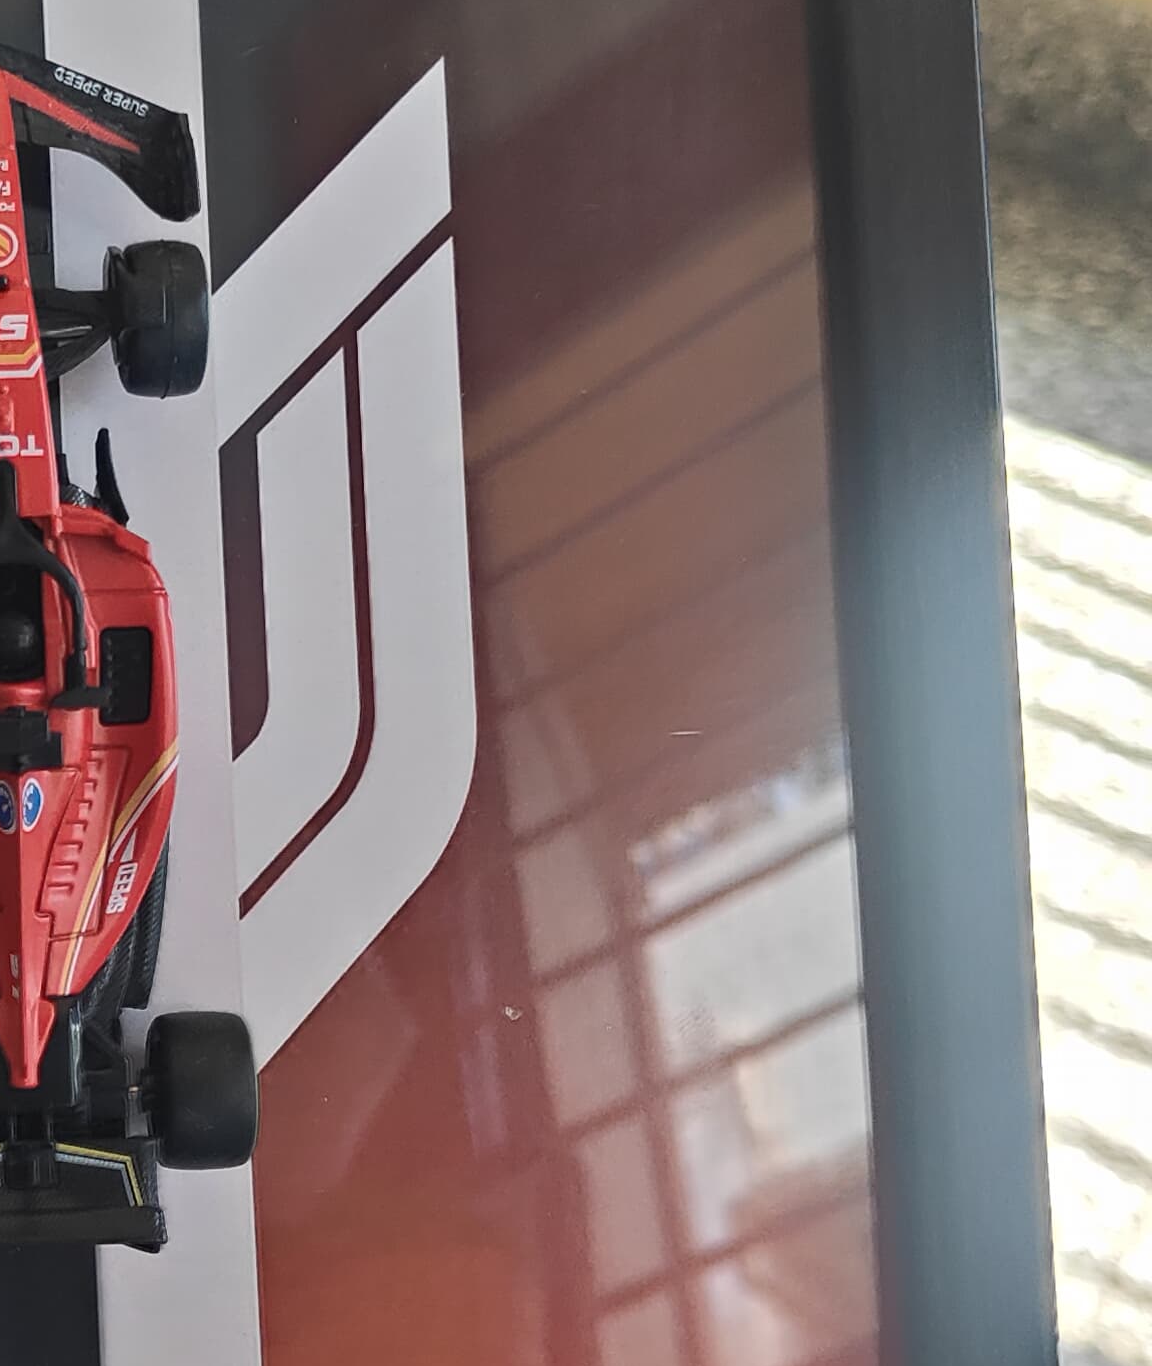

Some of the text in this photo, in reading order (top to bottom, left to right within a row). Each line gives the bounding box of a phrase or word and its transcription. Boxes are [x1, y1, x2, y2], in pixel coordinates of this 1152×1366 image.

[53, 67, 148, 117] SUPER SPEED
[106, 863, 137, 915] SPEED
